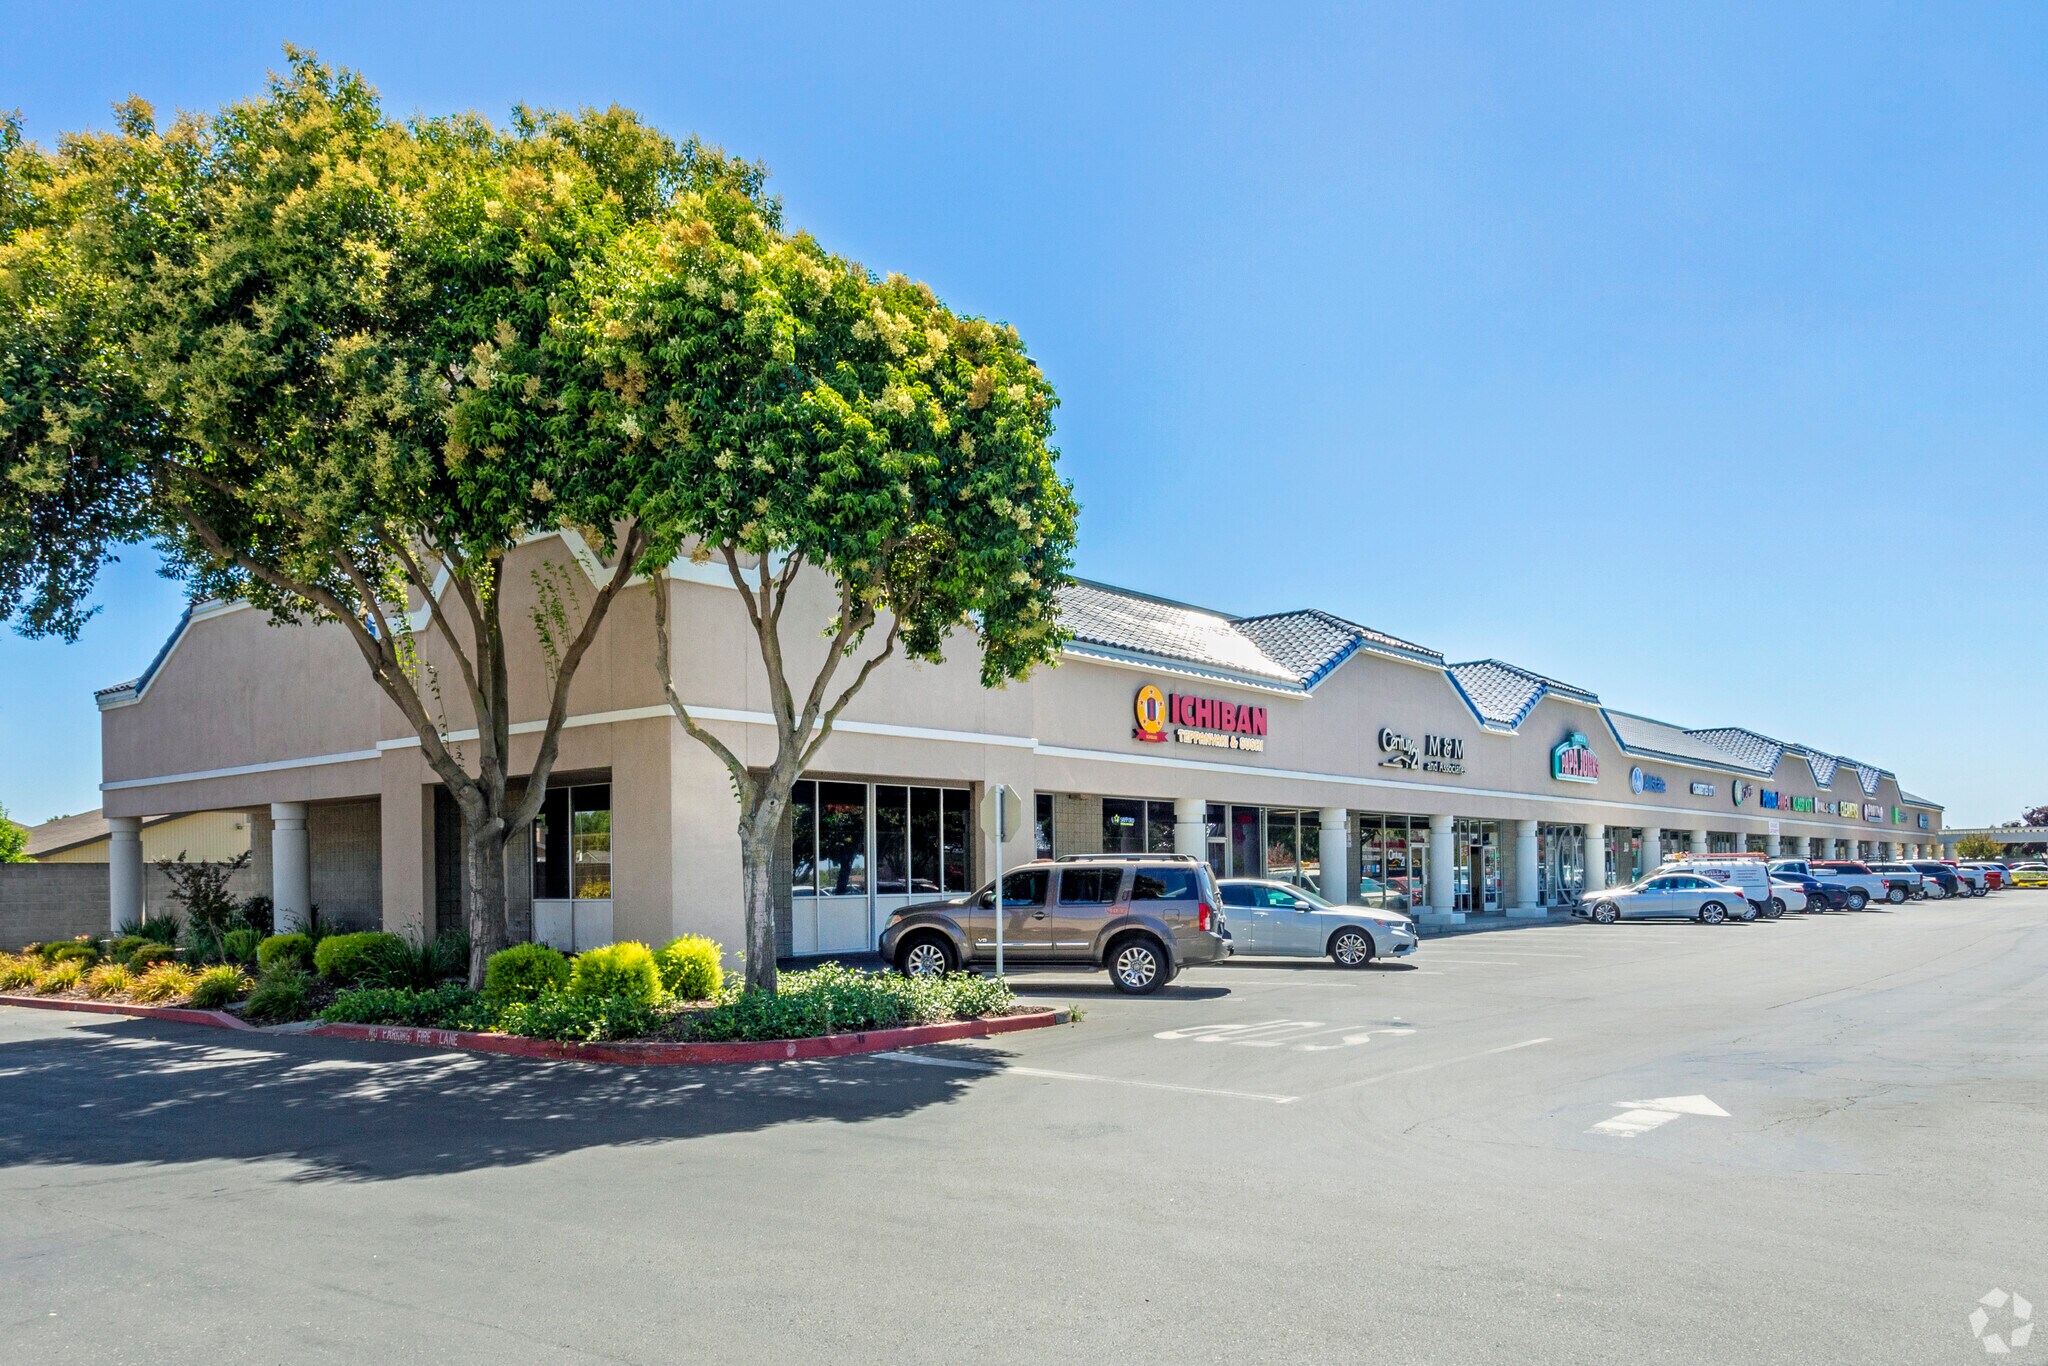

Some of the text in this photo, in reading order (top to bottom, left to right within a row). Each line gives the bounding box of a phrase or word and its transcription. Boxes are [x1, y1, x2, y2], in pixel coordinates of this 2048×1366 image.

[1170, 694, 1267, 736] ICHIBAN
[1177, 728, 1264, 752] TEPPANYAKI & SUSHI
[1382, 727, 1414, 755] Century
[1429, 735, 1465, 760] M & M
[1411, 747, 1420, 769] 21
[1561, 748, 1578, 775] PAPA
[368, 1028, 459, 1046] NO PARKING FIRE LANE
